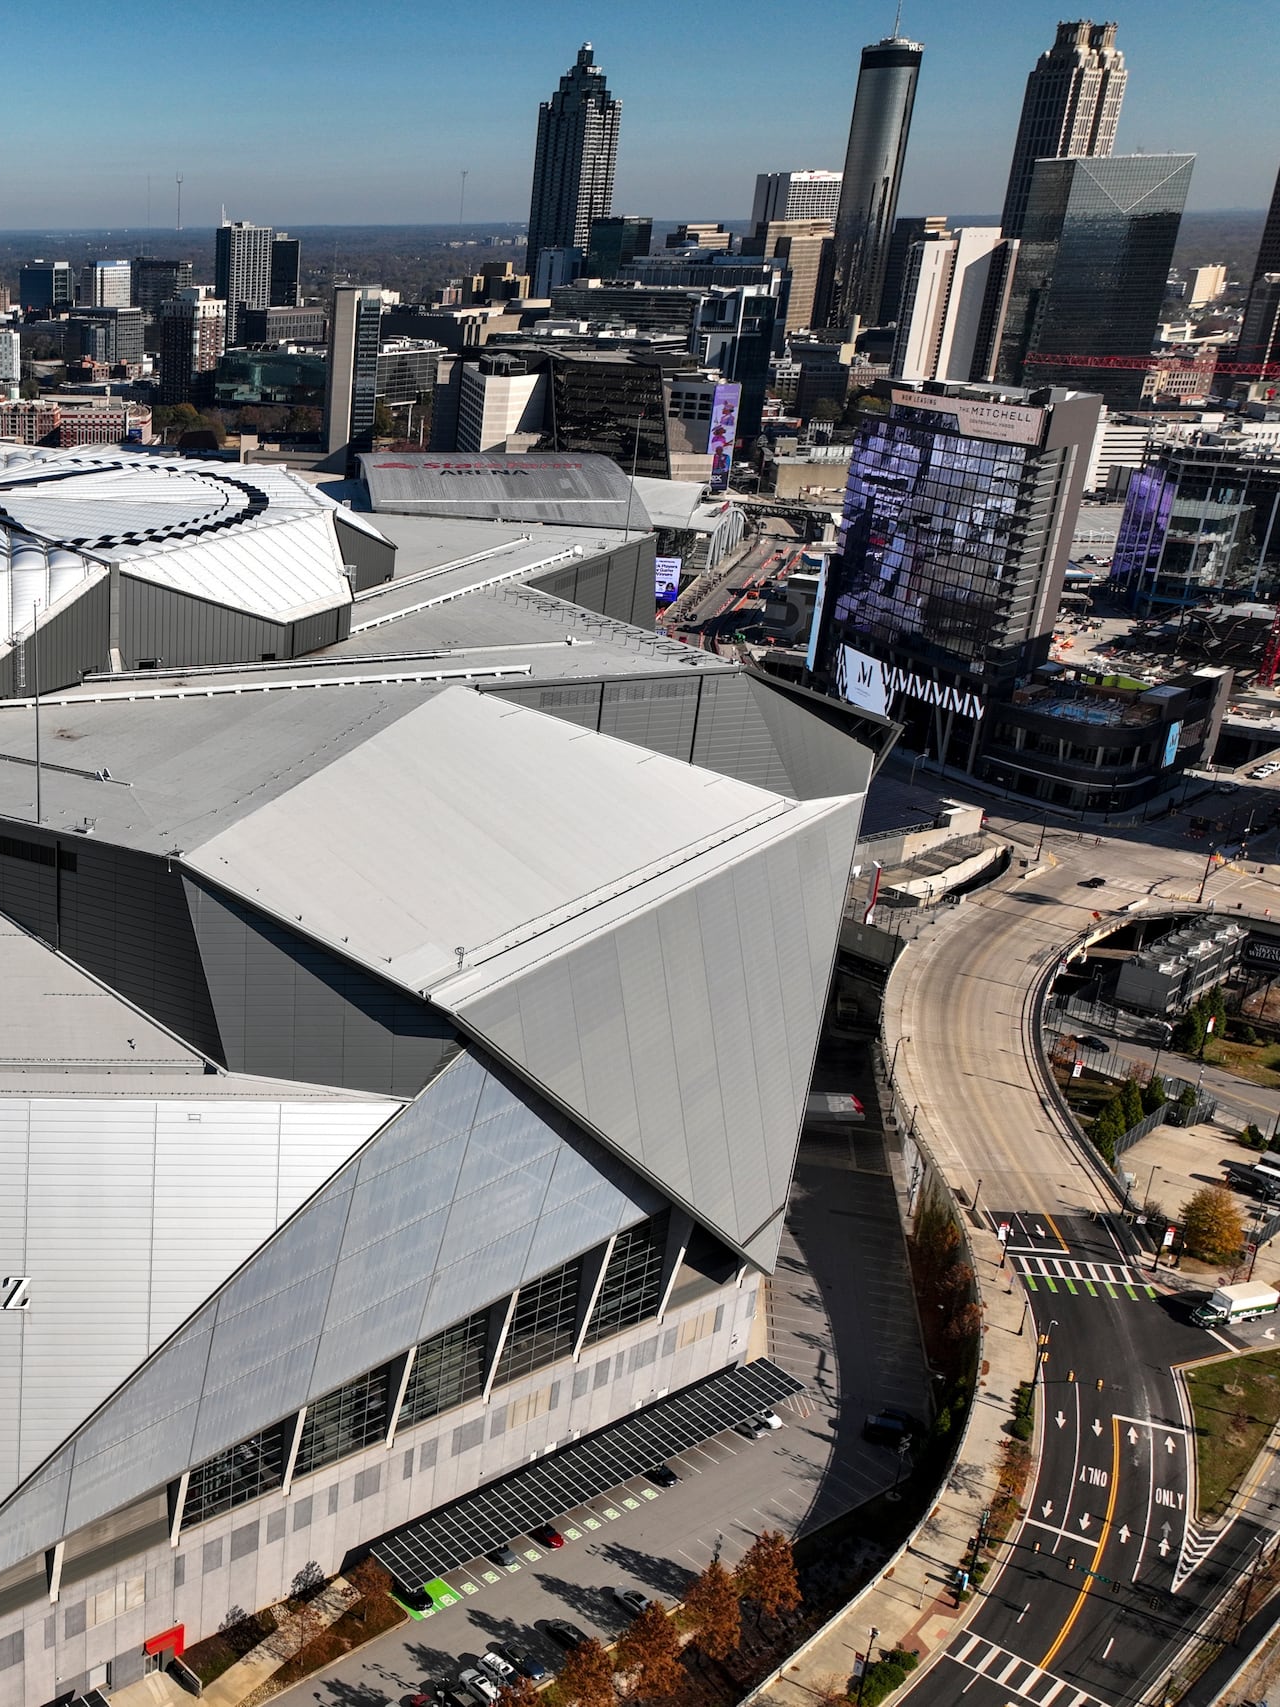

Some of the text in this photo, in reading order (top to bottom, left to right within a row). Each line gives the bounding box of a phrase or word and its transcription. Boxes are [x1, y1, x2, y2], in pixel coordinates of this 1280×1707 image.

[970, 407, 1032, 423] MITCHELL
[1079, 1465, 1108, 1488] ONLY
[1155, 1487, 1184, 1510] ONLY
